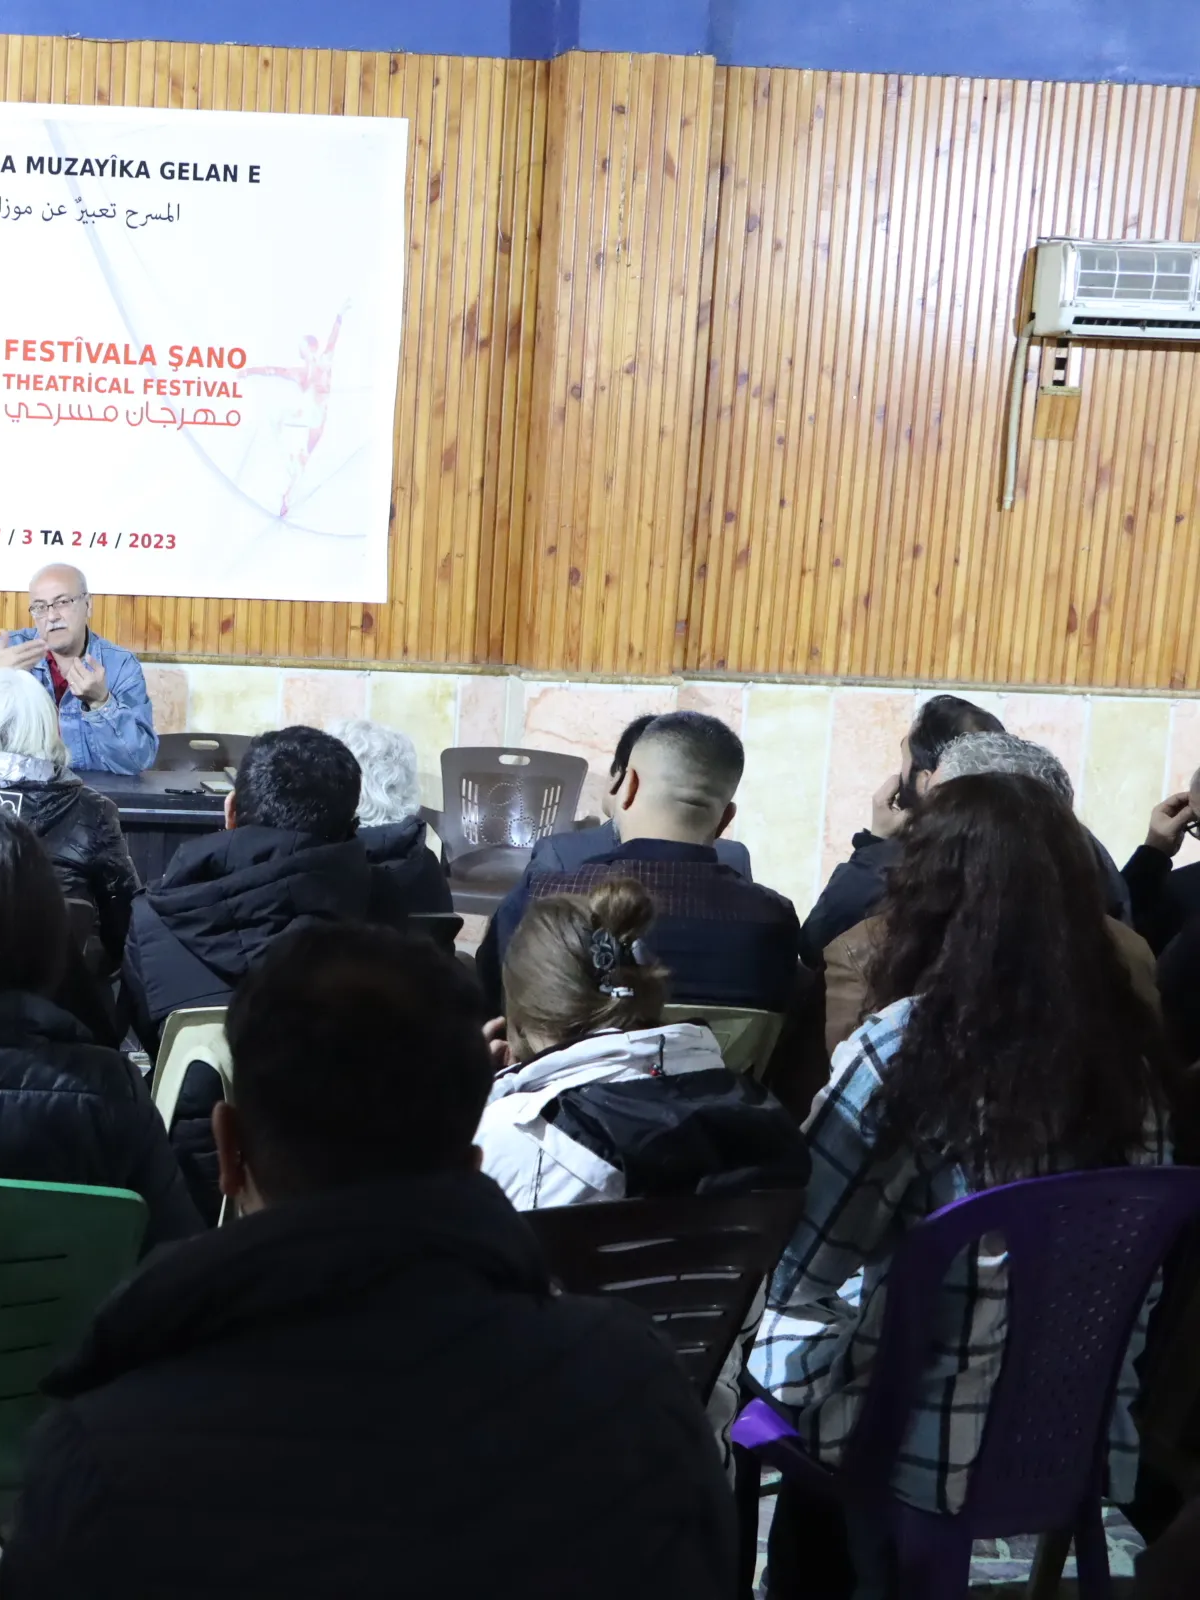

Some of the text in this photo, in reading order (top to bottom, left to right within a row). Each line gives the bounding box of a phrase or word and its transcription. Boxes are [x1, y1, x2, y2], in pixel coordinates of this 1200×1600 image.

[26, 154, 151, 180] MUZAYÎKA
[160, 161, 238, 183] GELAN
[249, 165, 261, 183] E
[41, 202, 67, 221] عن
[126, 203, 180, 229] المسرح
[4, 336, 247, 372] FESTÎVALA ŞANO
[5, 401, 241, 430] مهرجان مسرحي
[22, 529, 33, 545] 3
[40, 530, 64, 546] TA
[71, 531, 82, 546] 2
[128, 533, 177, 550] 2023
